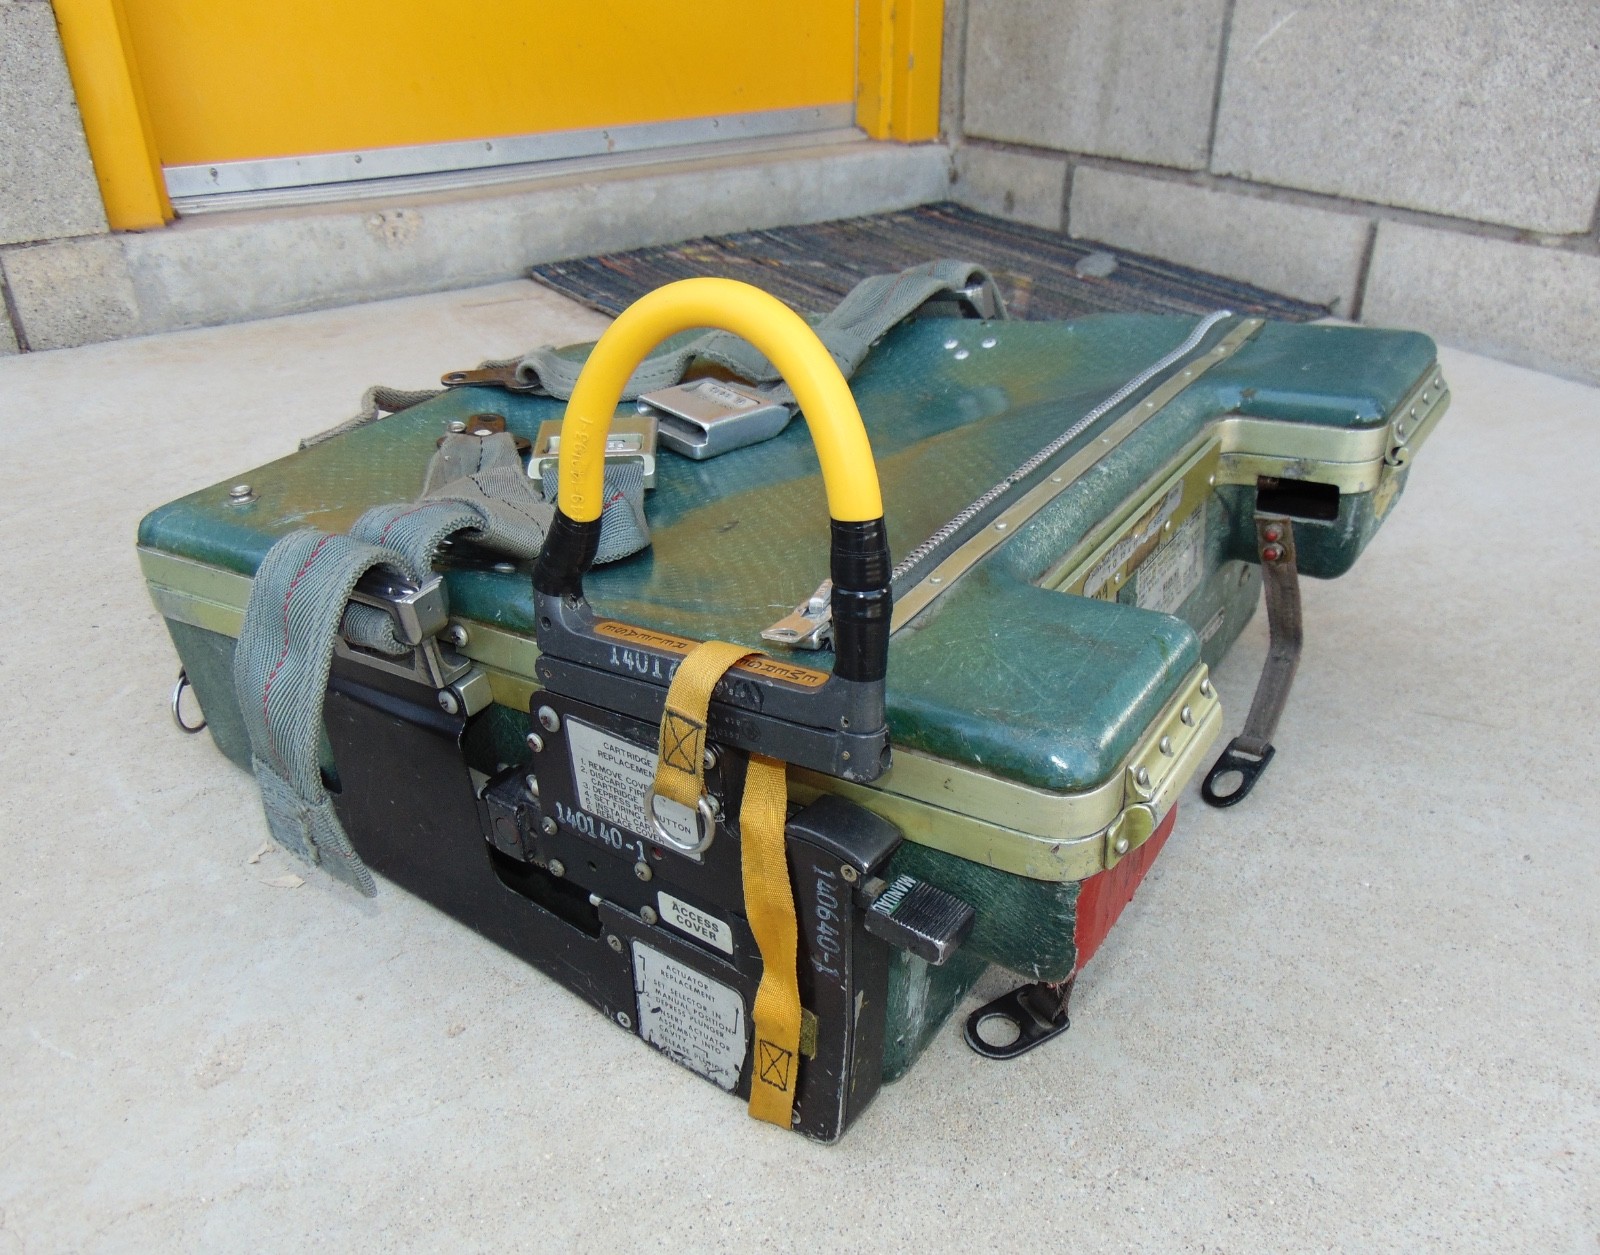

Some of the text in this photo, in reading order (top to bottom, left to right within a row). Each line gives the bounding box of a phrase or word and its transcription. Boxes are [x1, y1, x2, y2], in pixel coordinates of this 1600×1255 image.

[602, 624, 689, 650] RELEASE
[737, 657, 819, 683] EMERGE
[597, 750, 656, 779] REPLACEMEN
[603, 742, 652, 768] CARTRIDGE
[588, 760, 622, 780] REMOVE
[626, 776, 649, 791] COVE
[590, 770, 626, 790] DISCARD
[592, 778, 638, 803] CARTRIDGE
[592, 786, 632, 808] DEPRESS
[594, 793, 610, 805] SET
[614, 801, 641, 822] FIRING
[596, 802, 630, 822] INSTALL
[596, 810, 633, 831] REPLACE
[871, 874, 916, 916] MANUAL
[672, 902, 719, 932] ACCESS
[676, 914, 717, 942] COVER
[660, 970, 716, 1003] REPLACEMENT
[666, 964, 709, 990] ACTUATOR
[654, 978, 665, 990] SET
[670, 988, 708, 1012] SELECTOR
[712, 1010, 722, 1020] IN
[655, 988, 688, 1011] MANUAL
[656, 996, 686, 1018] DEPRESS
[658, 1016, 722, 1056] ASSEMBLY INTO
[659, 1024, 688, 1043] CAVITY
[688, 1025, 731, 1052] ACTUATOR
